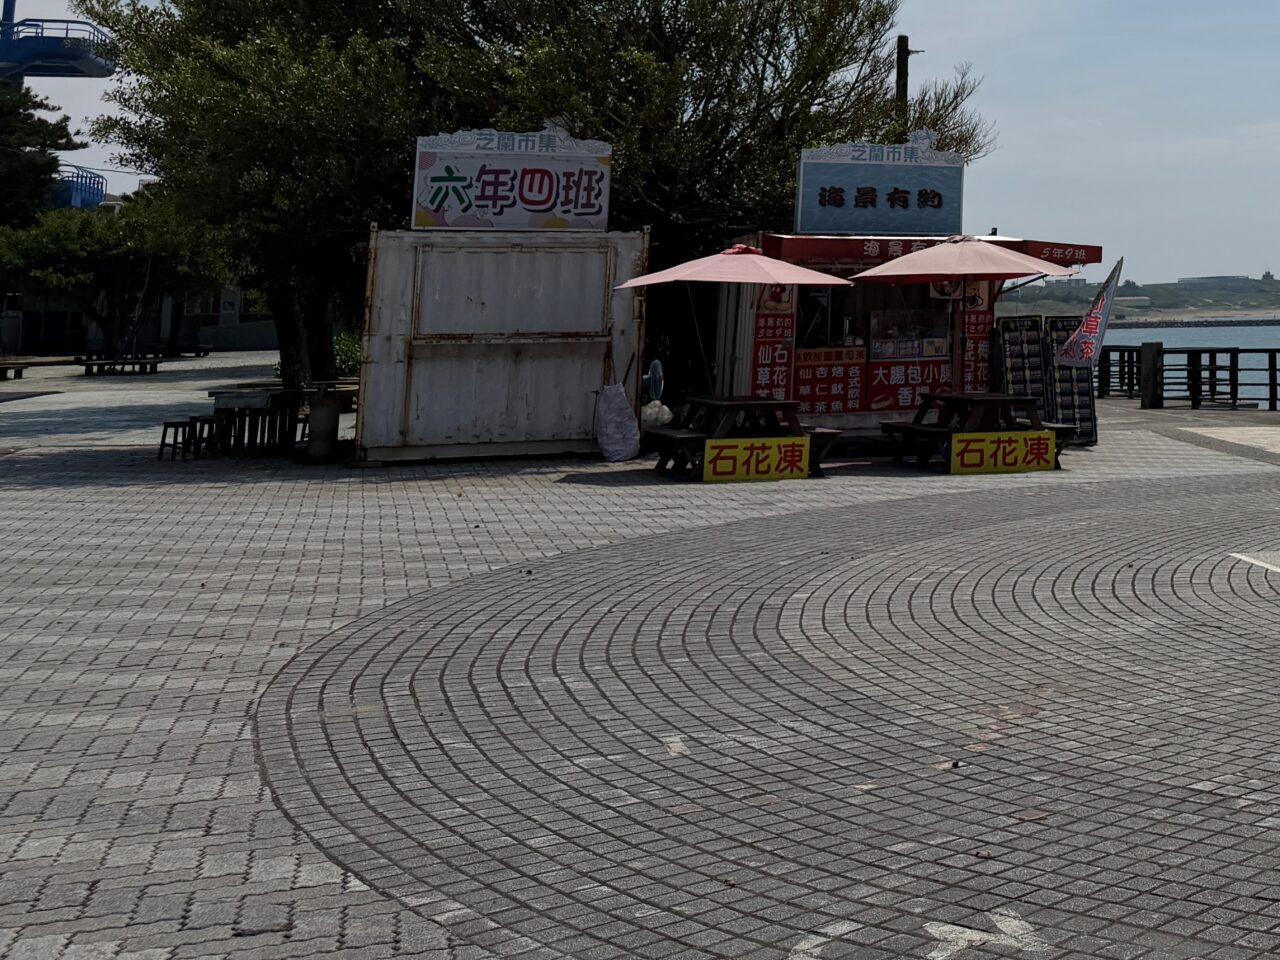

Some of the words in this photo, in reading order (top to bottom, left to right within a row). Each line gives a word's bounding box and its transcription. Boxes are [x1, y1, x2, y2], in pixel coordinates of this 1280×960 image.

[475, 131, 558, 152] 芝蘭市集
[851, 143, 920, 163] 芝蘭市集
[429, 164, 603, 215] 六年四班
[818, 186, 943, 210] 海景有約
[1040, 247, 1087, 260] 5年9班
[797, 367, 812, 413] 仙草茶
[815, 366, 829, 413] 杏仁茶
[848, 366, 861, 409] 各式飲料
[872, 364, 953, 385] 大腸包小腸
[708, 442, 806, 477] 石花凍
[955, 436, 1053, 469] 石花凍
